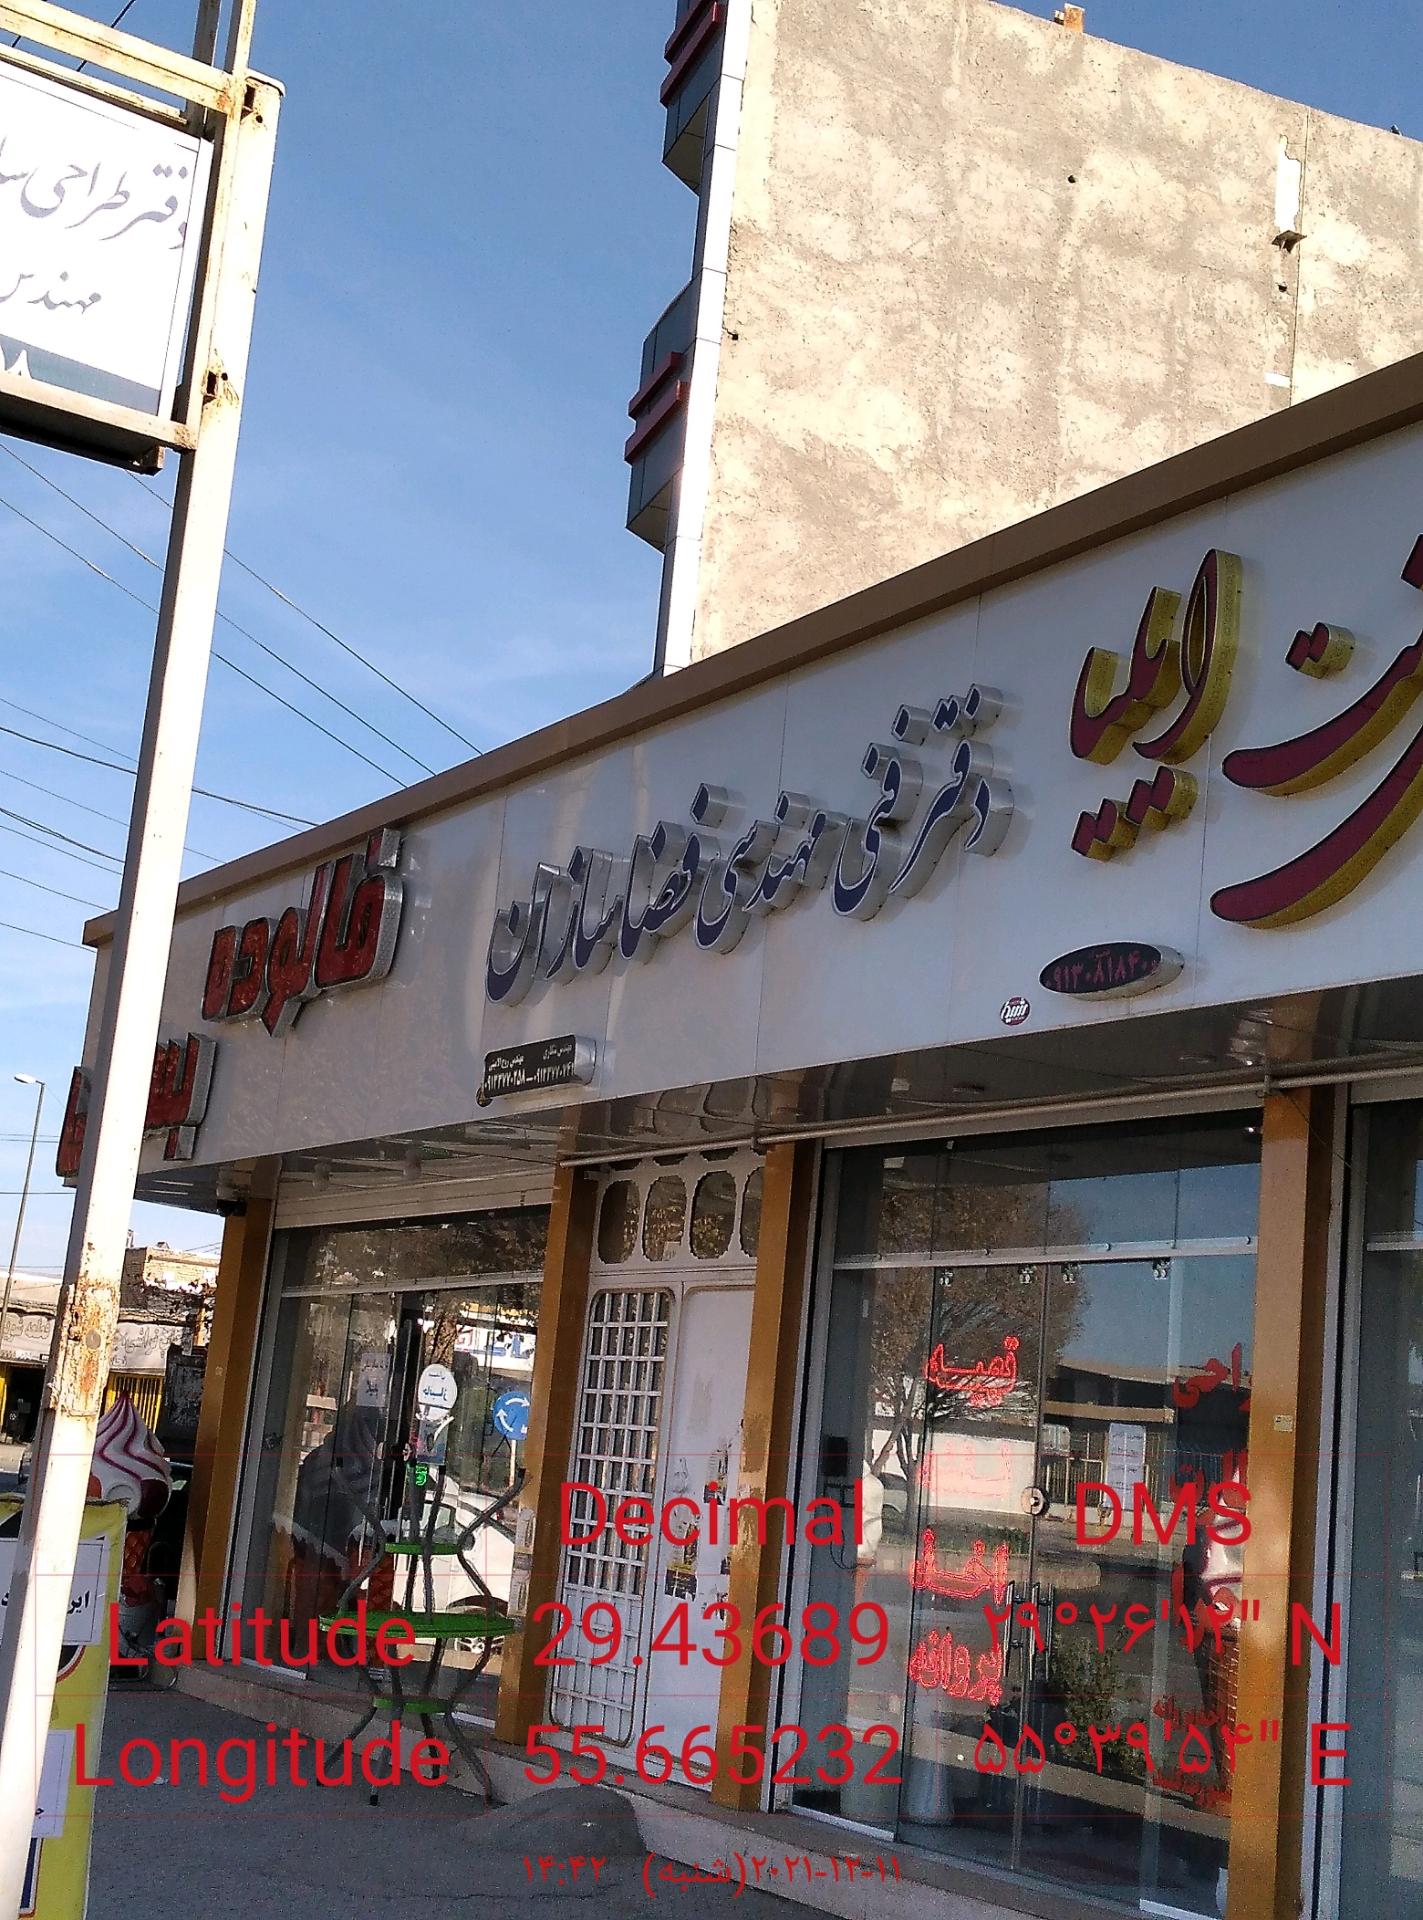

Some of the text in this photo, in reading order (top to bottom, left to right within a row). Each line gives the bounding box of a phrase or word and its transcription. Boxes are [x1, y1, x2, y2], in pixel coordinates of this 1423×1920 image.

[20, 161, 131, 229] طراحی
[694, 790, 850, 954] مهندسی
[832, 704, 924, 921] فنی
[888, 683, 1014, 896] دفتر
[201, 827, 404, 1037] فالوده
